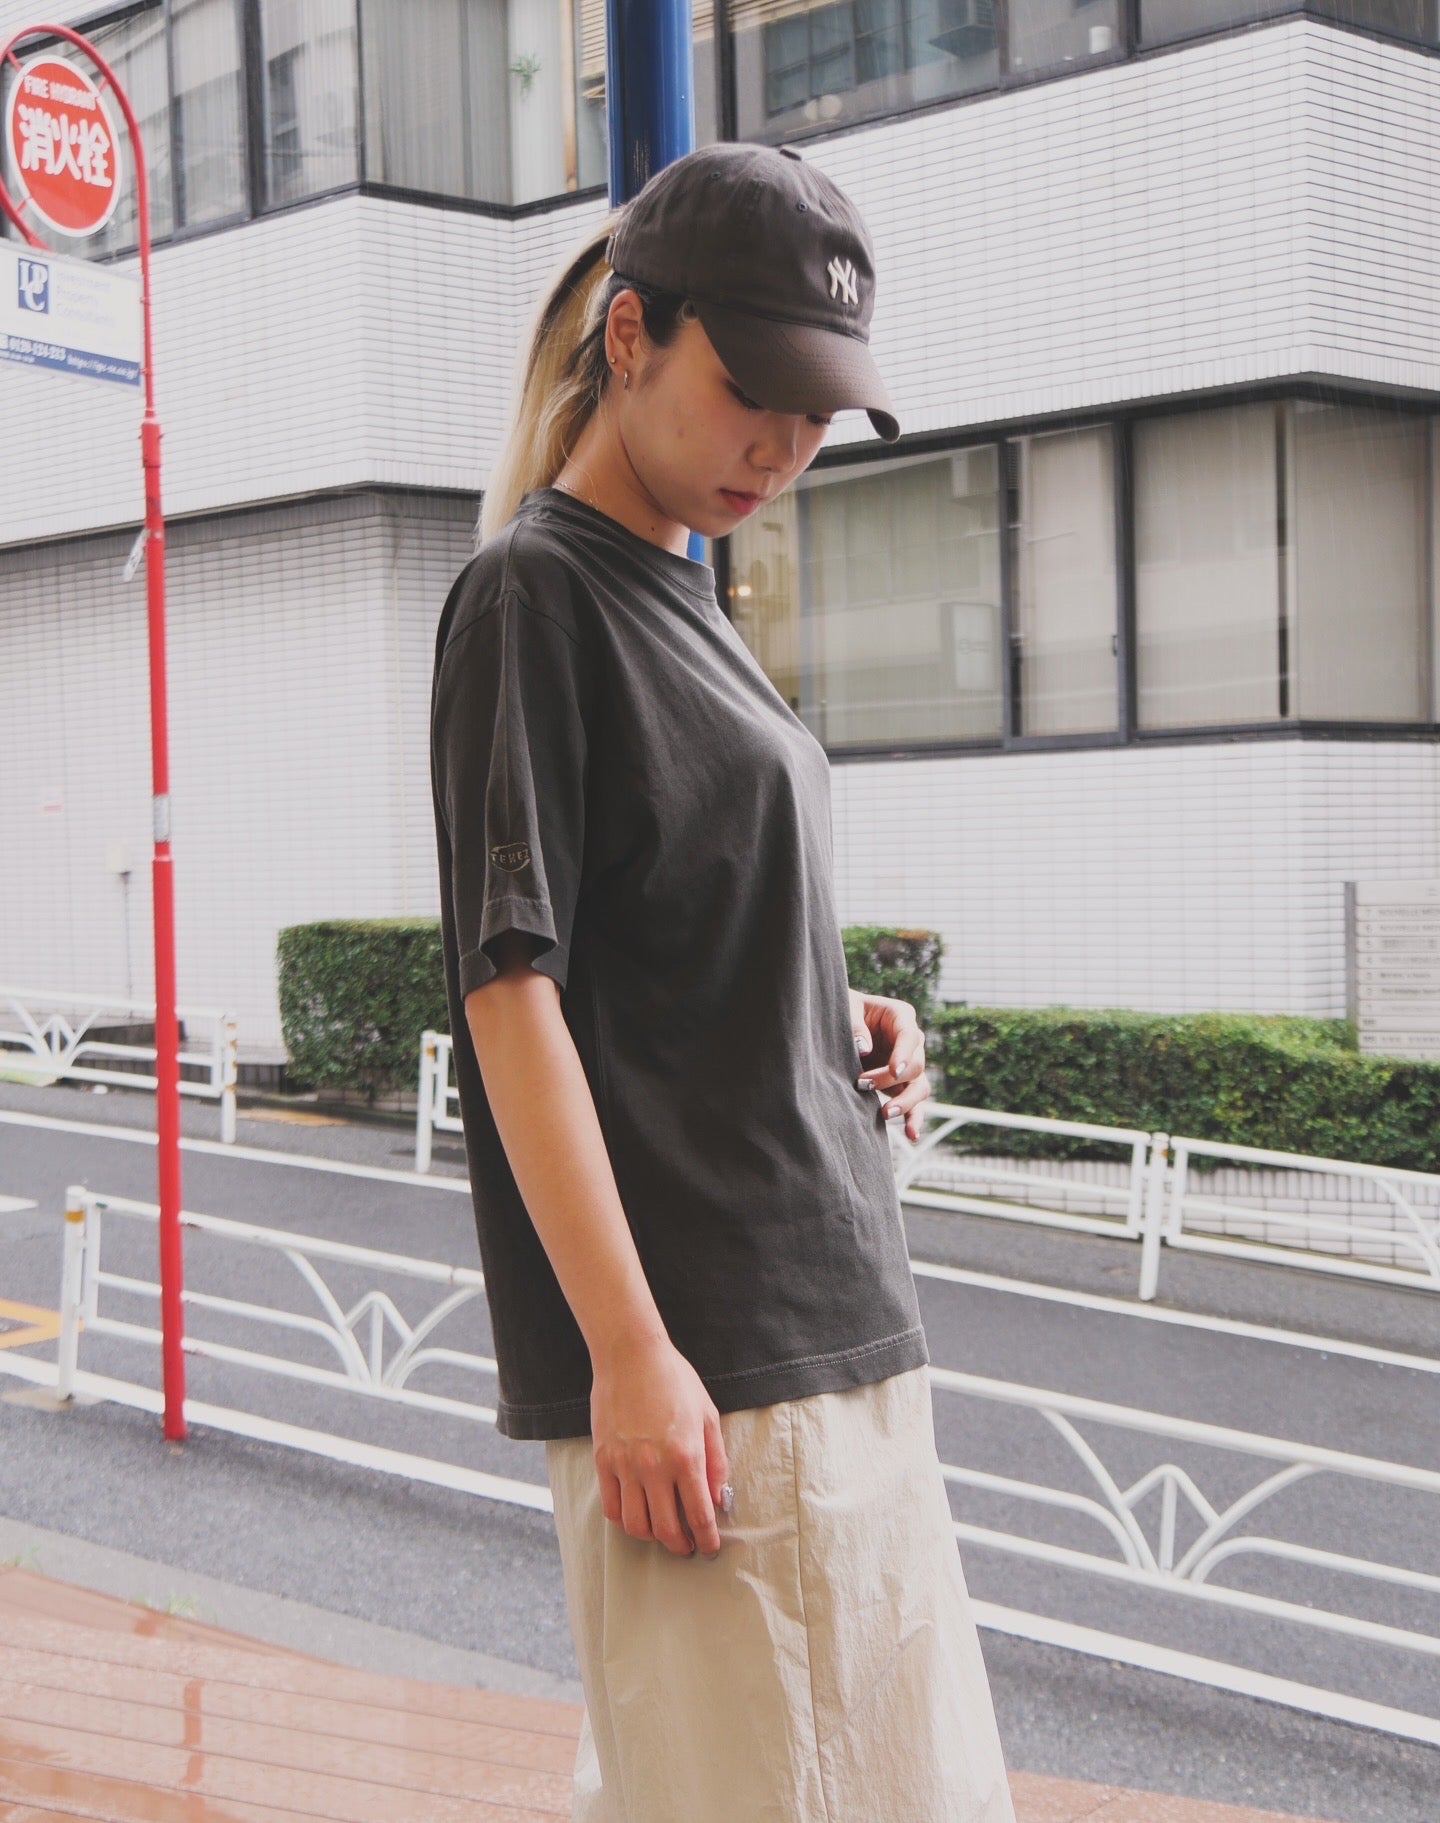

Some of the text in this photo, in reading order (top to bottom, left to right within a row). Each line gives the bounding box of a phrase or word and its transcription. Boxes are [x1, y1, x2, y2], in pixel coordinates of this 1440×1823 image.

[24, 75, 49, 98] FIRE
[18, 104, 112, 187] 消火栓
[827, 256, 858, 304] NY
